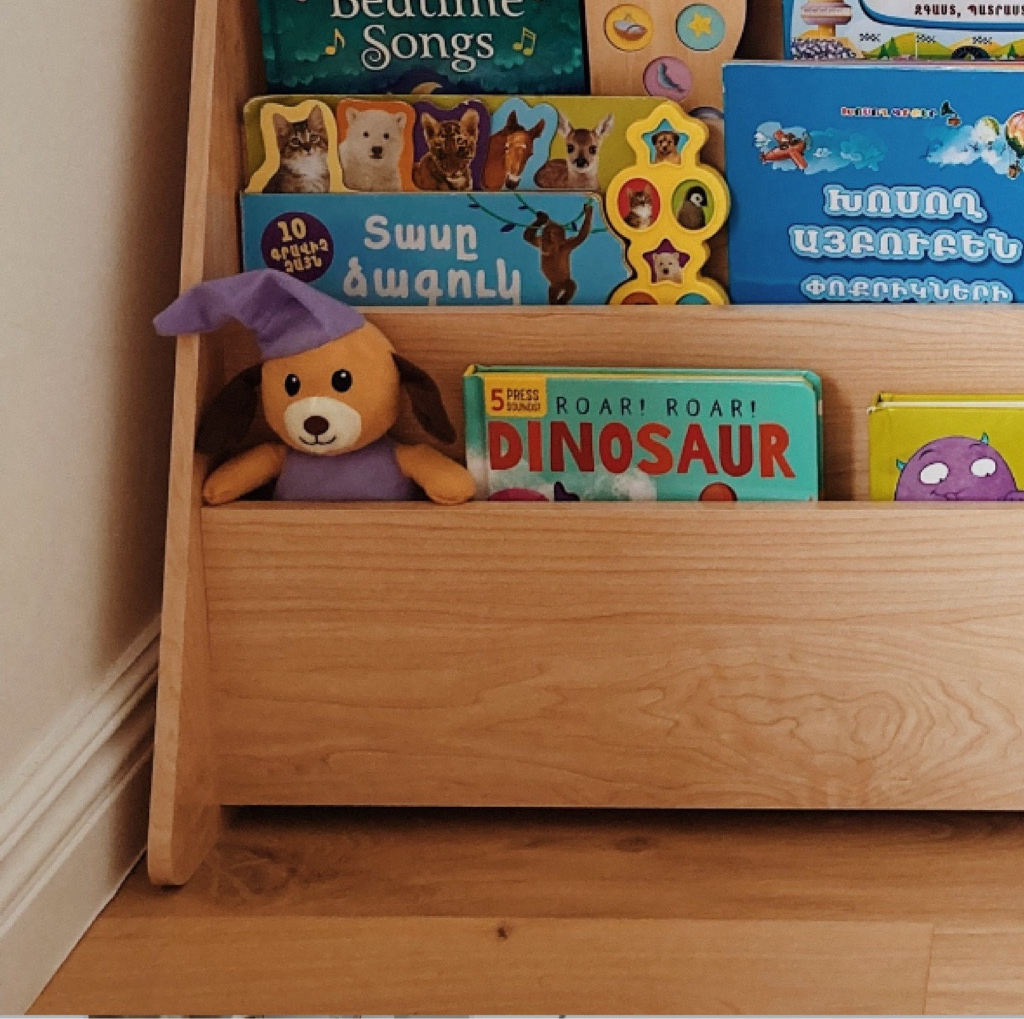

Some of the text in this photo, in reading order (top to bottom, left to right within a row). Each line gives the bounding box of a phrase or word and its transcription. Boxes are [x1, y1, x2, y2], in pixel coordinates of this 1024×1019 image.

[361, 25, 494, 72] Songs
[825, 187, 985, 220] ԽՈՍՈՂ
[278, 217, 306, 242] 10
[364, 214, 478, 261] Տասը
[791, 227, 1021, 261] ԱՅԲՈՒԲԵՆ
[343, 256, 521, 305] ձագուկ
[804, 278, 1010, 302] ՓՈՔՐԻԿՆԵՐԻ
[491, 388, 540, 411] 5 PRESS
[556, 396, 757, 419] ROAR! ROAR!
[487, 420, 796, 479] DINOSAUR
